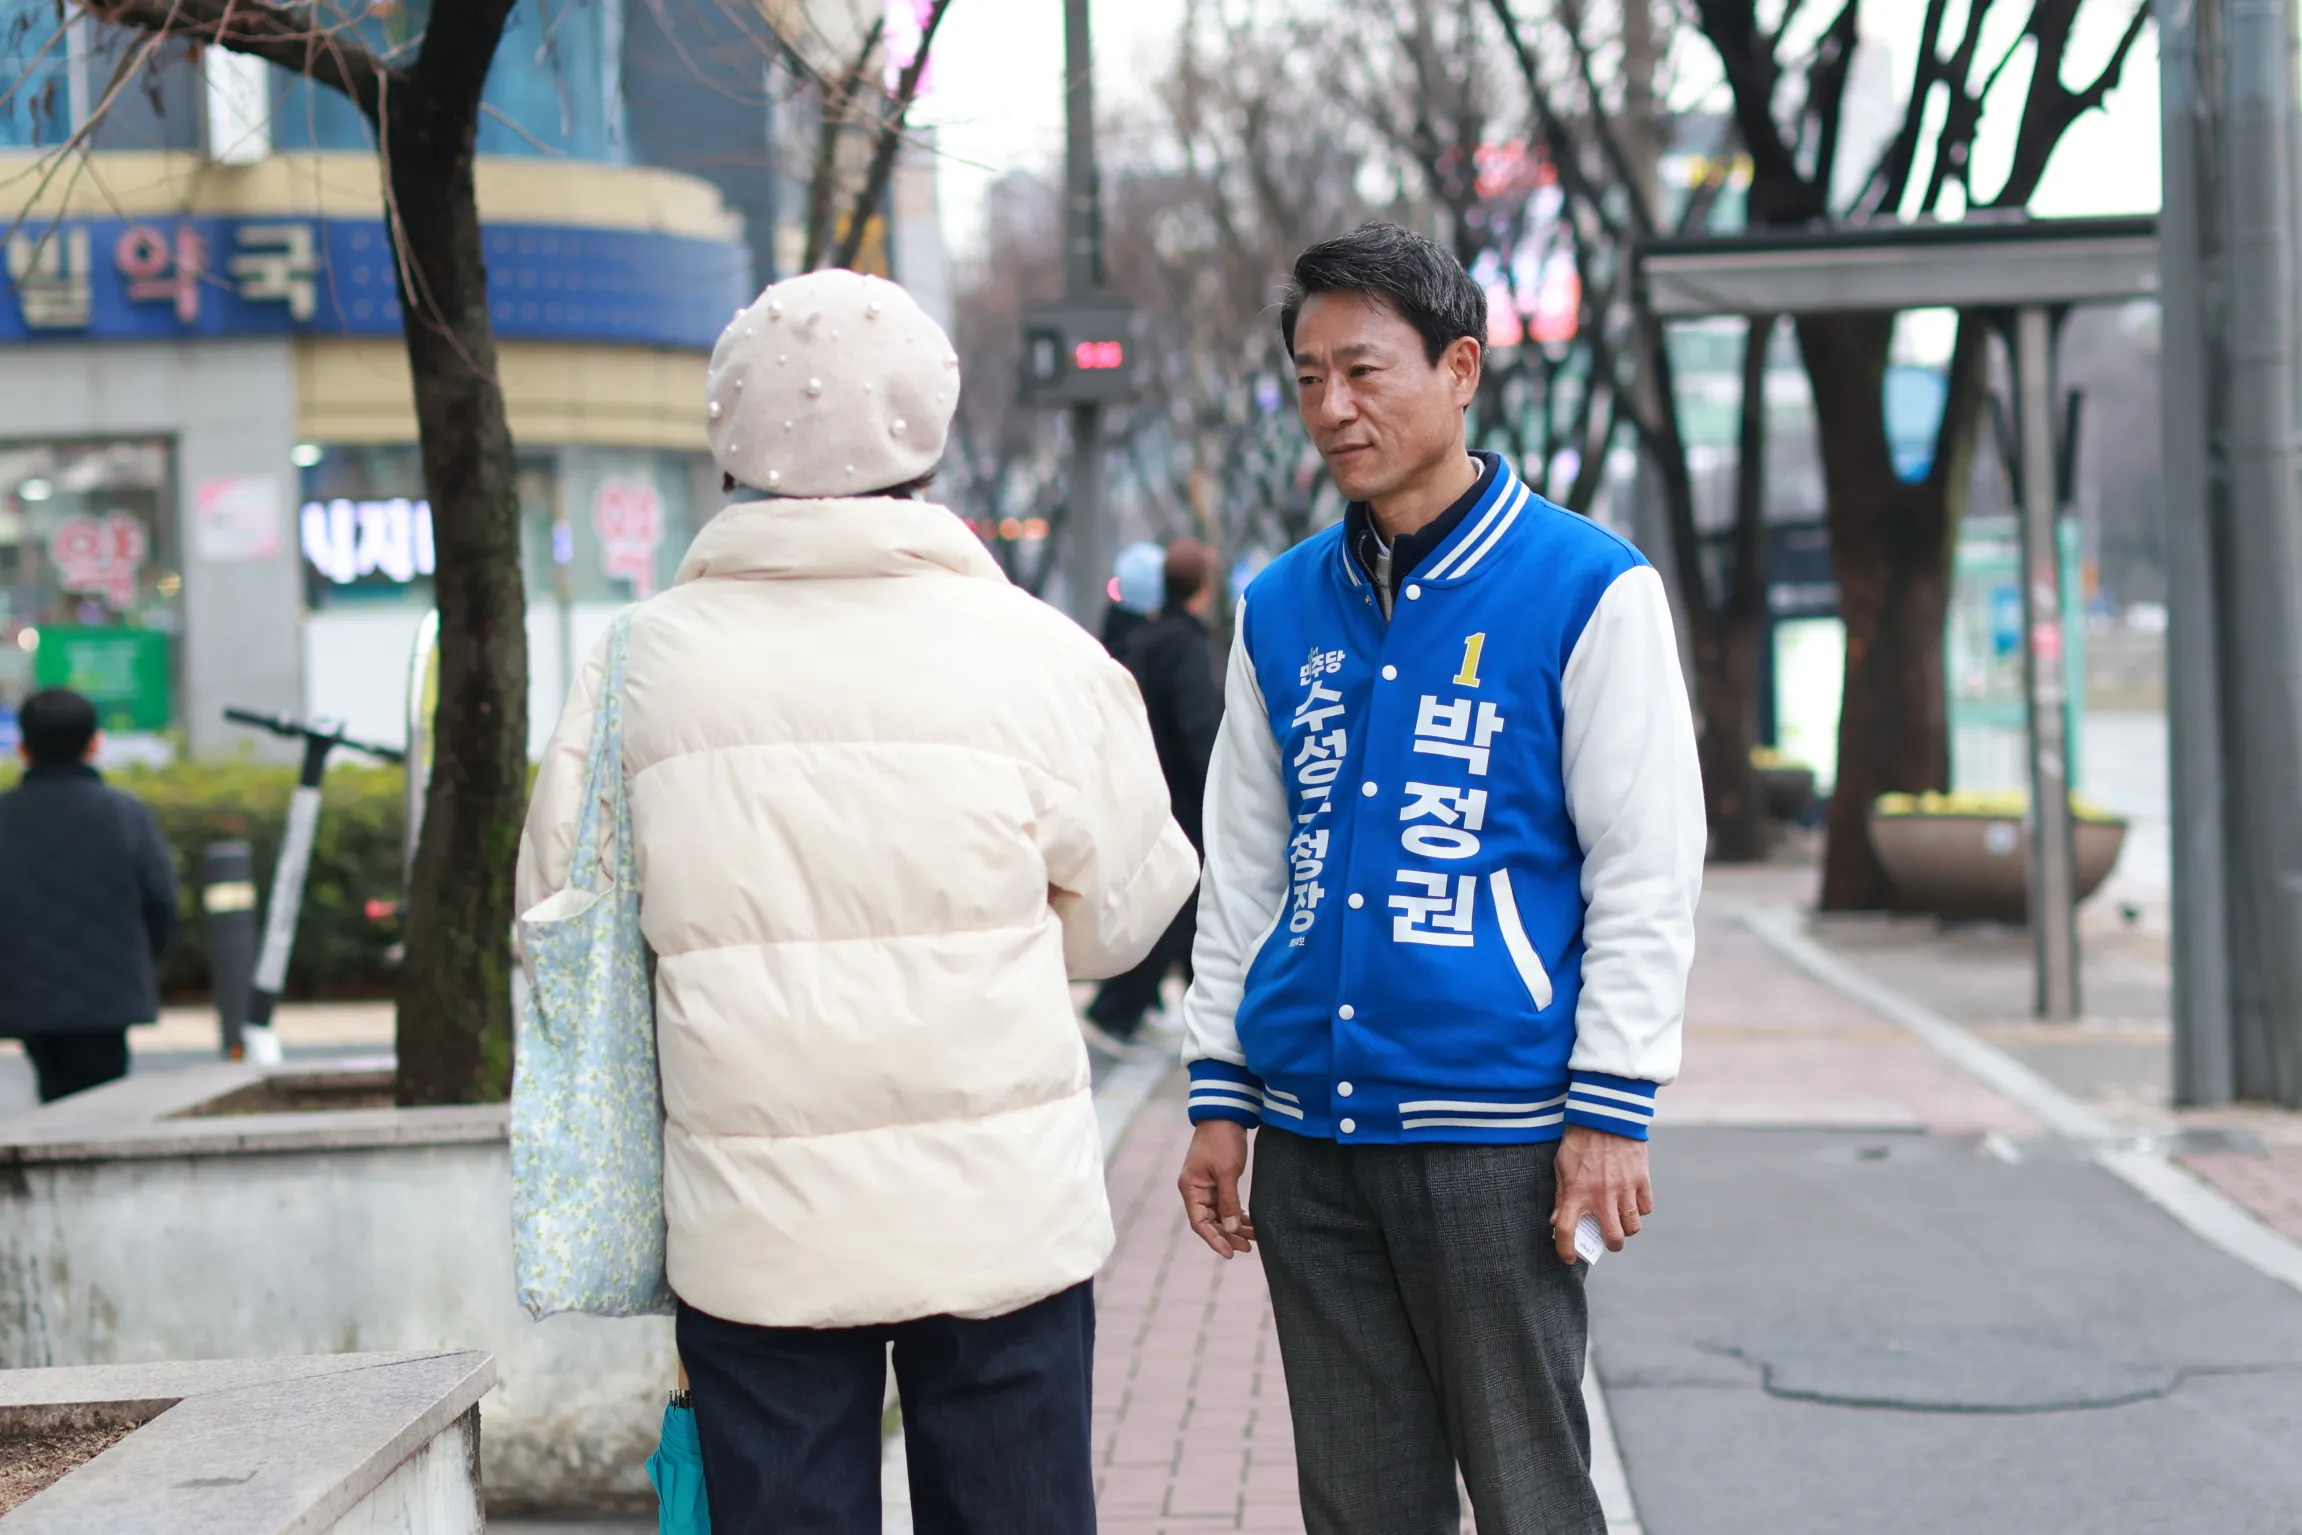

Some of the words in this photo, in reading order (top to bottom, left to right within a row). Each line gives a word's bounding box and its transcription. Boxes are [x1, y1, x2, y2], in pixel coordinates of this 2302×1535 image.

[1299, 650, 1346, 686] 민주당
[1452, 632, 1486, 688] 1
[1388, 694, 1505, 947] 박정권
